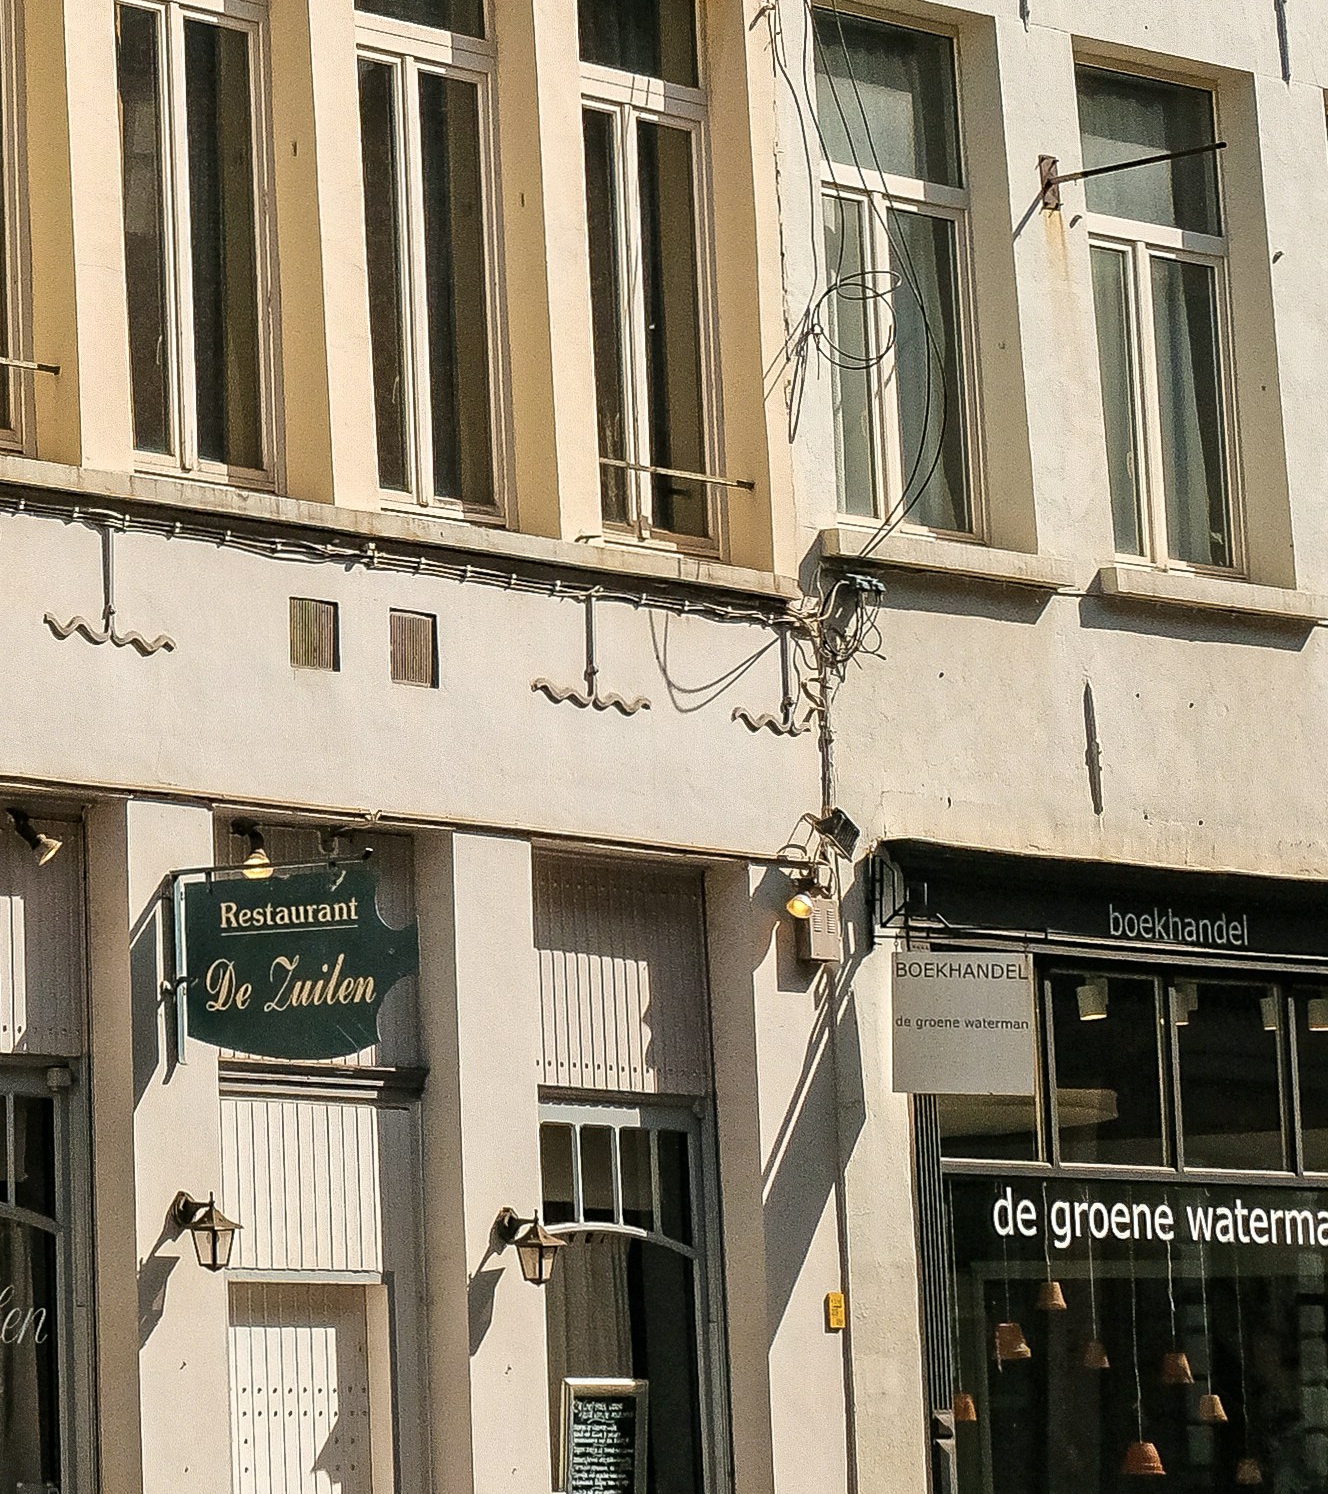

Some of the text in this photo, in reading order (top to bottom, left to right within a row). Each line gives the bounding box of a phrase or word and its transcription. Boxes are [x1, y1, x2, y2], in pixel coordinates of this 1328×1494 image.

[220, 897, 358, 928] Restaurant
[1109, 904, 1249, 946] boekhandel
[205, 953, 376, 1013] De Zuilen
[895, 961, 1030, 980] BOEKHANDEL
[895, 1015, 1029, 1031] de groene waterman
[993, 1186, 1037, 1237] de
[1050, 1201, 1174, 1249] groene
